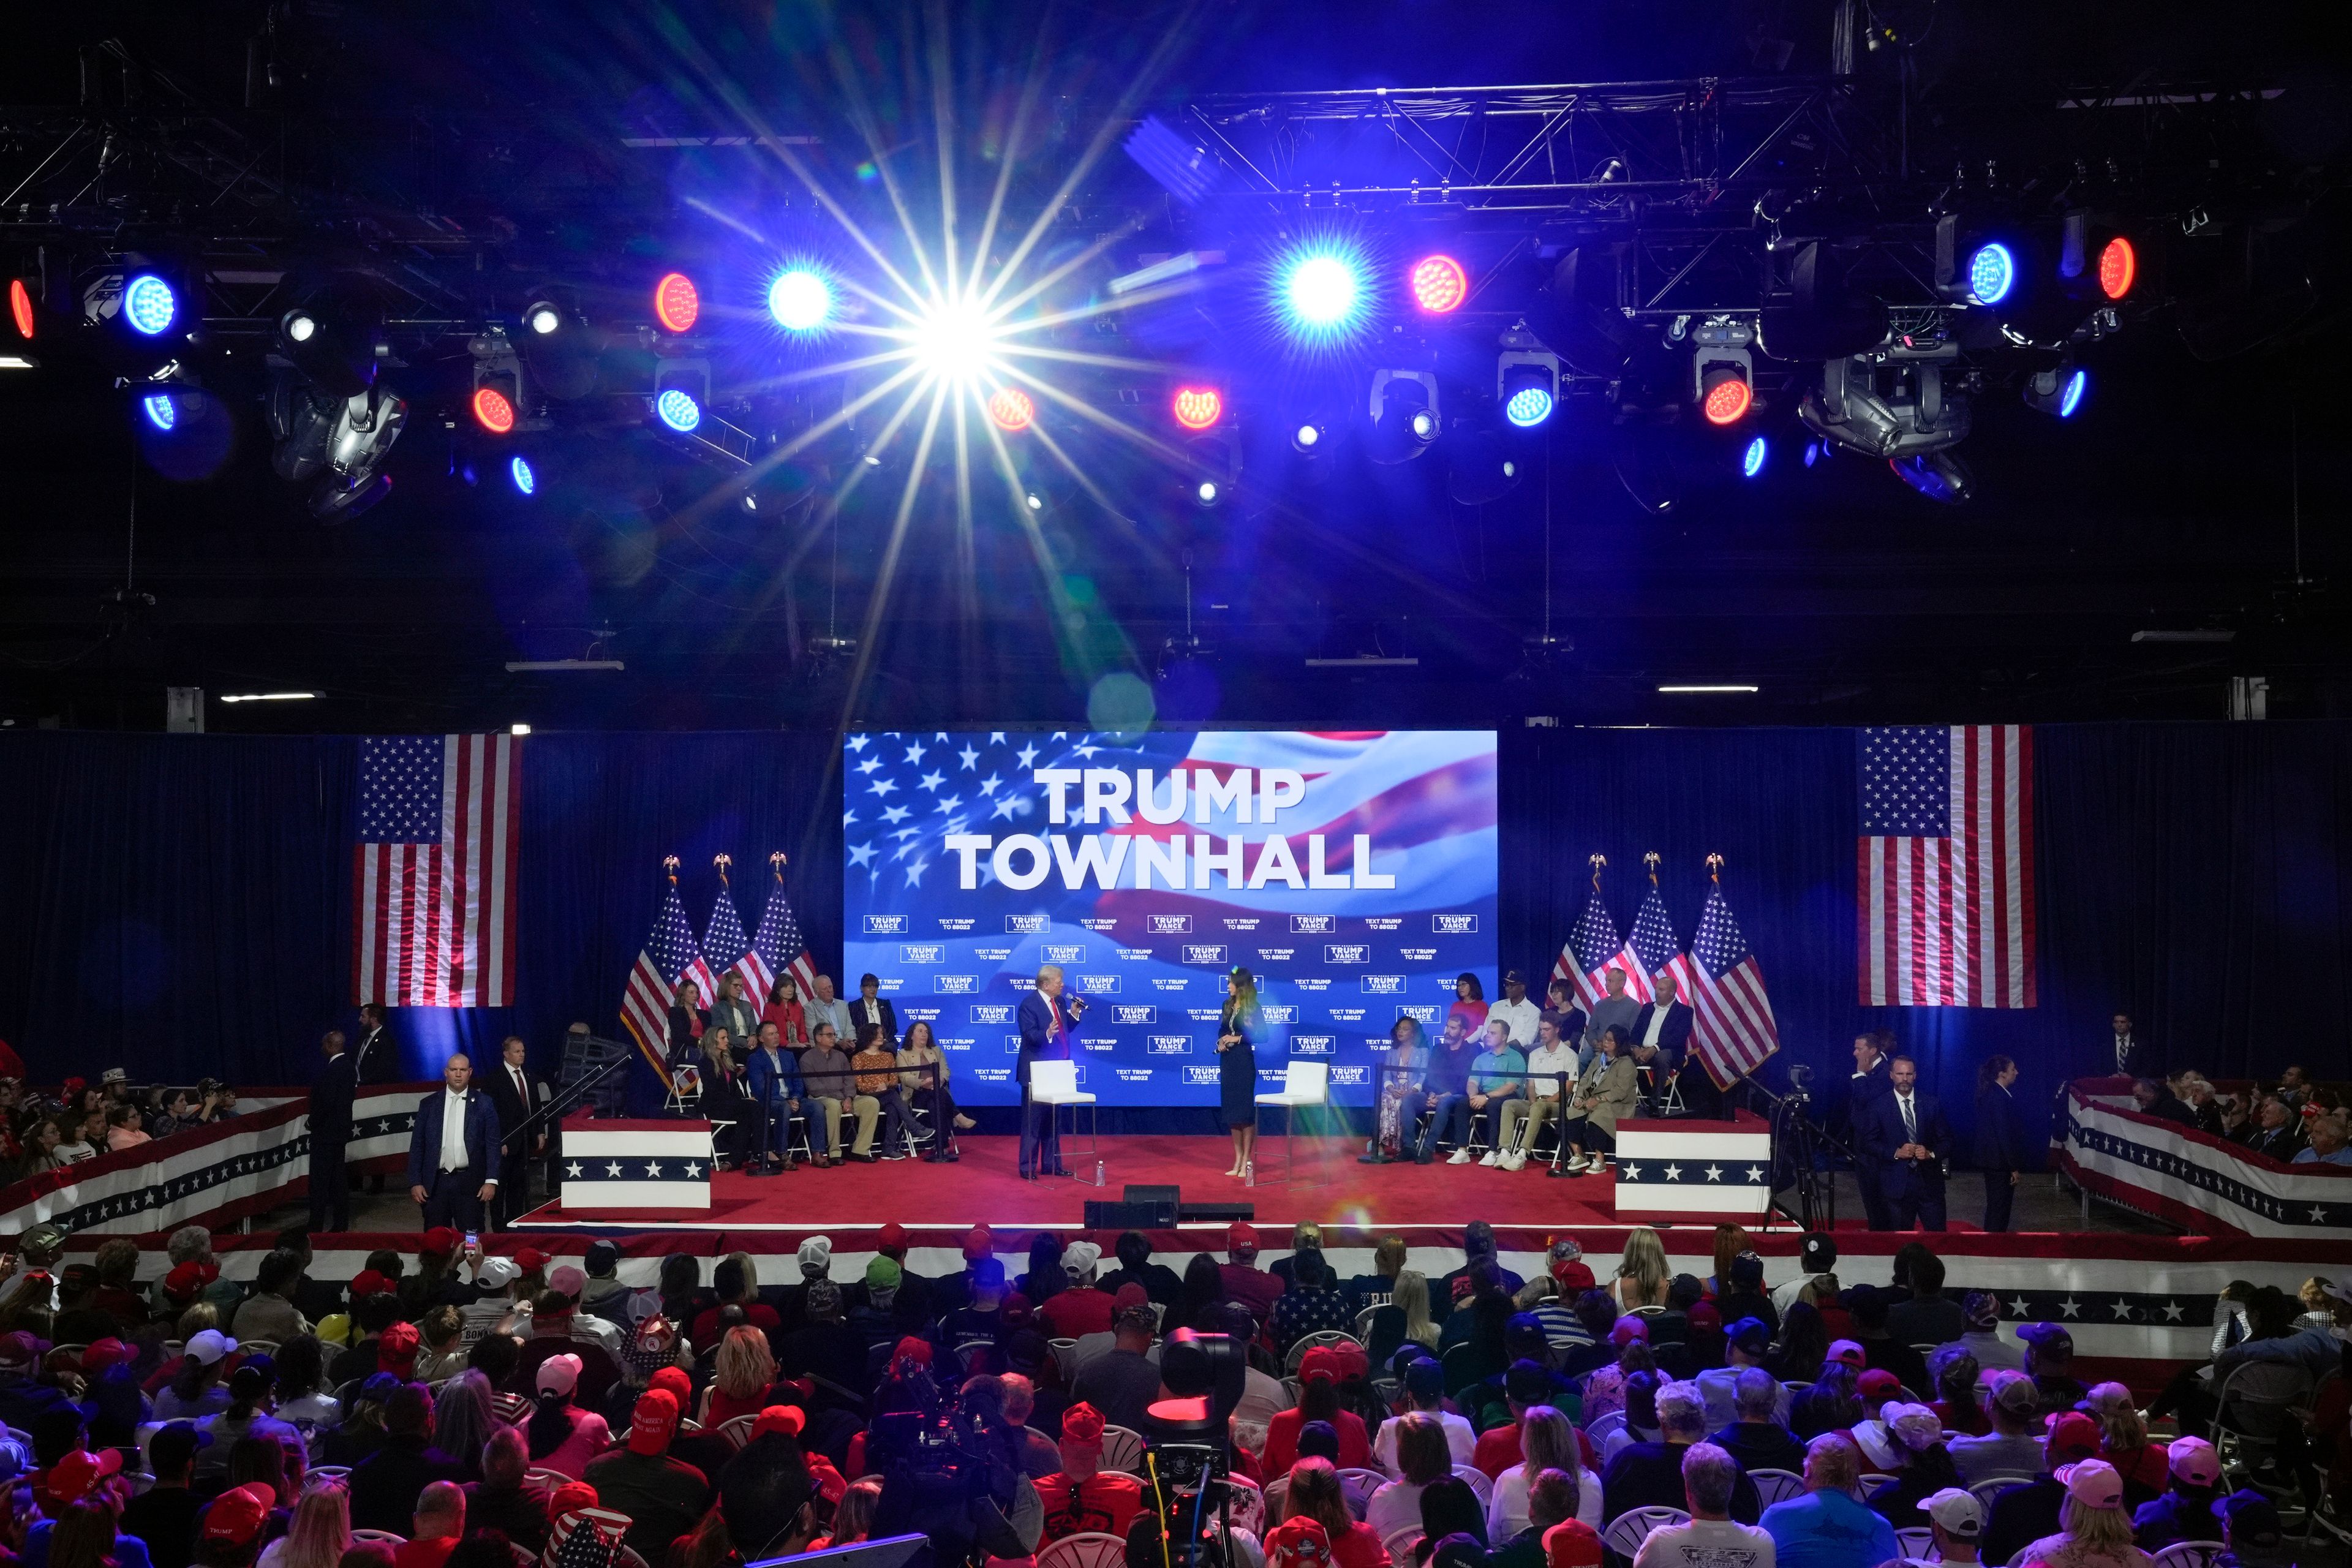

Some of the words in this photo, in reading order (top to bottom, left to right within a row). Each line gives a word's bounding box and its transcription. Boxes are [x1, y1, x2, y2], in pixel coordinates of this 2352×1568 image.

[1034, 769, 1305, 824] TRUMP
[944, 834, 1395, 890] TOWNHALL
[1360, 1292, 1392, 1306] TRU
[85, 1470, 100, 1490] 45-47
[823, 1487, 839, 1499] 45-47
